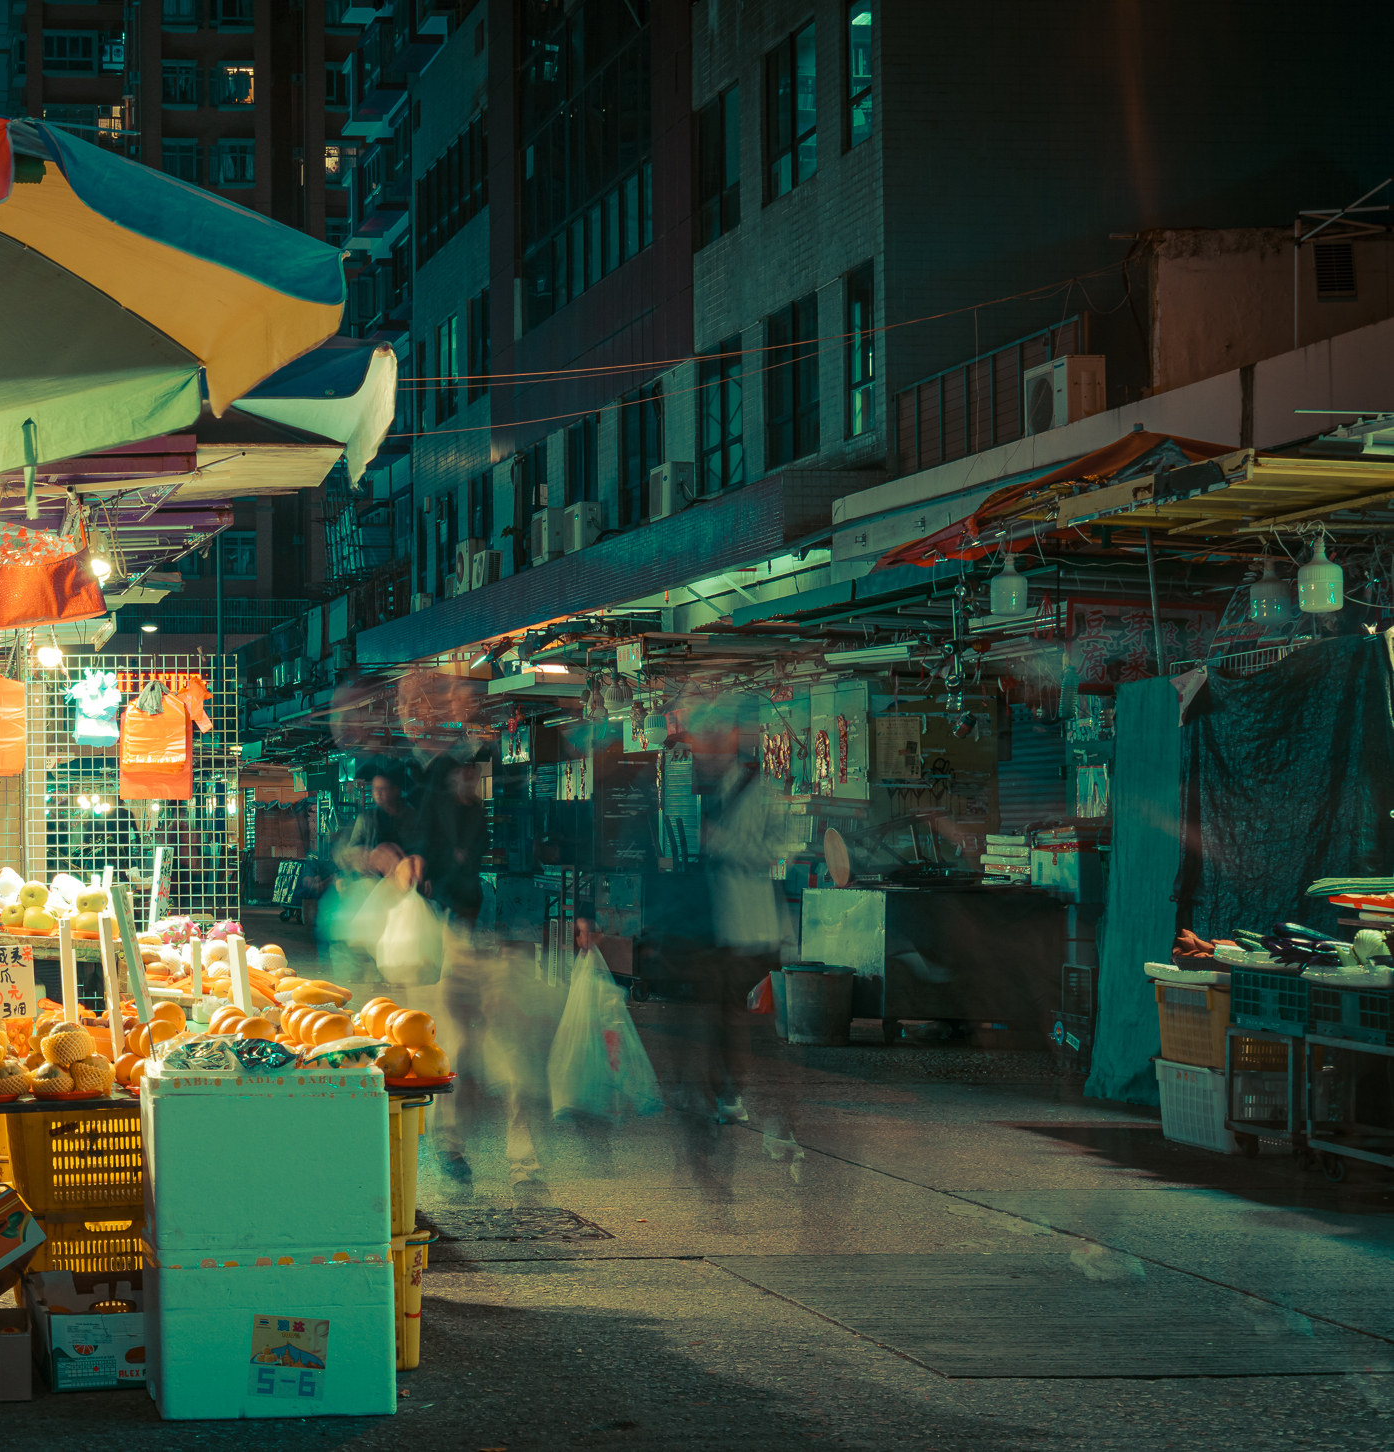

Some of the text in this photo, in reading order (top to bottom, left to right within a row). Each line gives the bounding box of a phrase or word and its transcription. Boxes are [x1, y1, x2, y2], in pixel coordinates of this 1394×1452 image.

[1077, 610, 1112, 682] 豆腐
[1121, 610, 1155, 681] 芽菜
[2, 1002, 26, 1018] 3個
[183, 1077, 213, 1087] XBL
[118, 1369, 140, 1378] ALEX
[257, 1368, 316, 1397] 5-6
